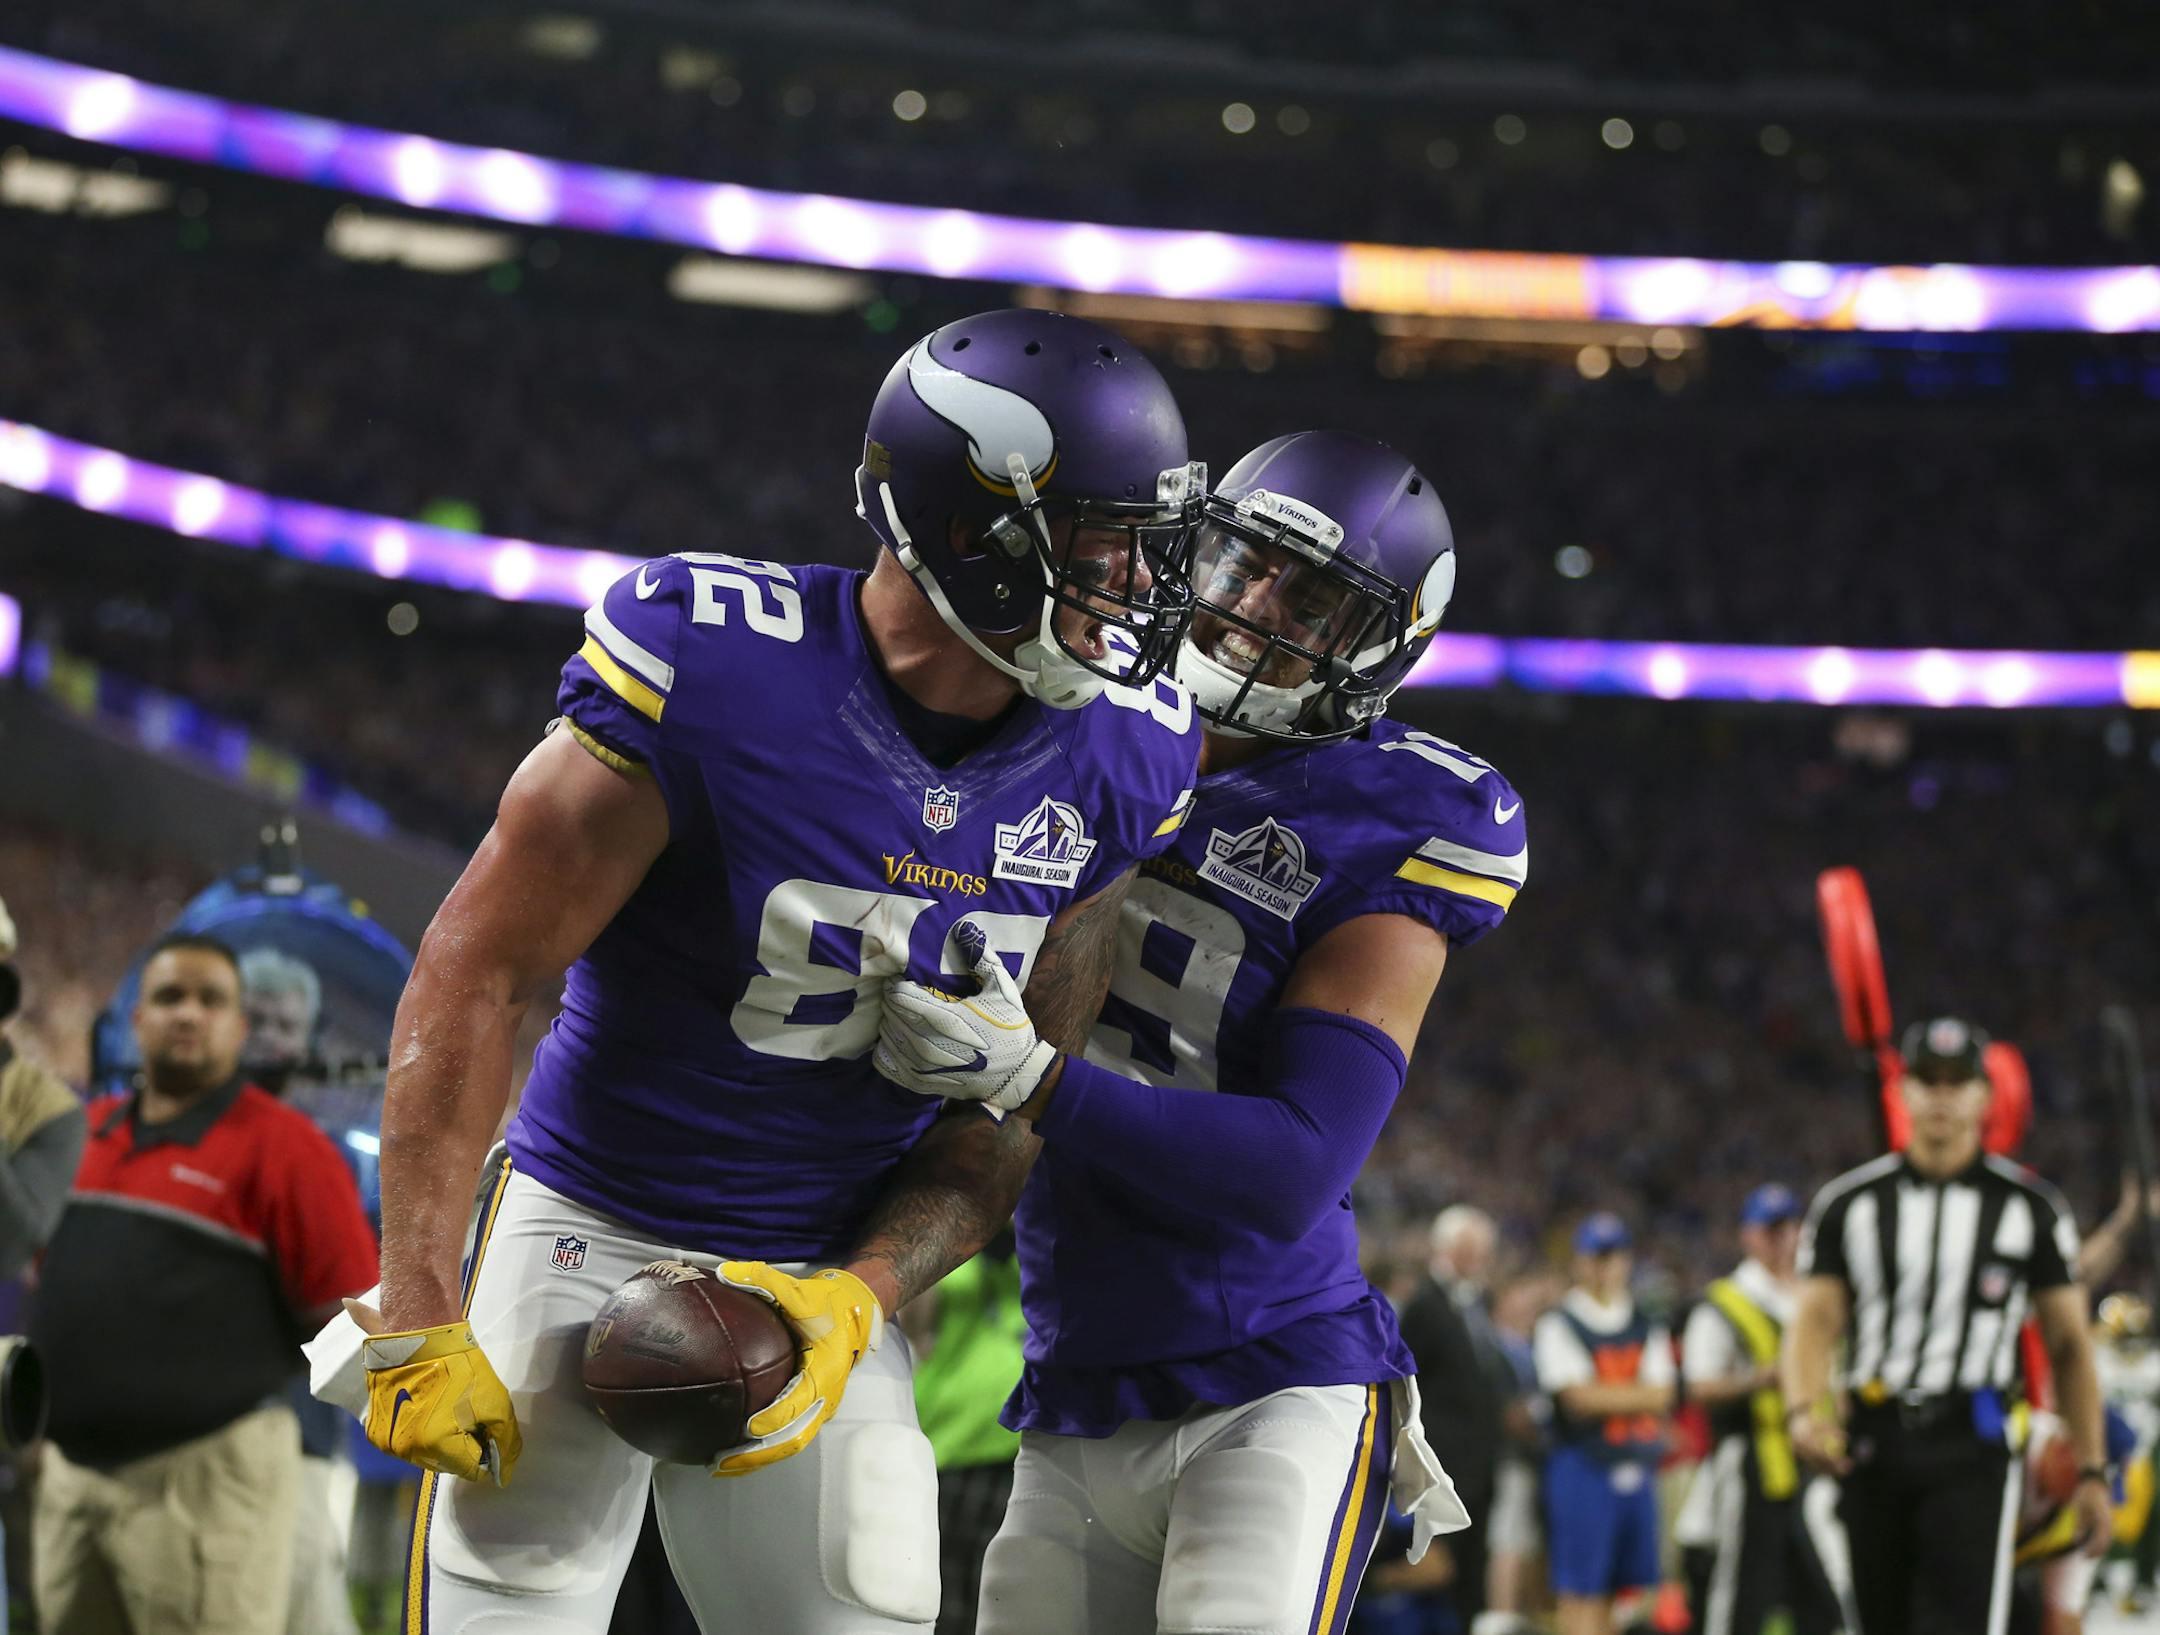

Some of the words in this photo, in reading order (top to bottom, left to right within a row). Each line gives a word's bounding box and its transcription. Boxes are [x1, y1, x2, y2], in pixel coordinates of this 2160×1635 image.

[927, 805, 950, 824] NFL
[1001, 860, 1042, 880] INAUGURAL
[1044, 868, 1071, 882] SEASON
[1207, 863, 1254, 897] INAUGURAL
[1254, 888, 1291, 914] SEASON
[555, 1249, 580, 1267] NFL
